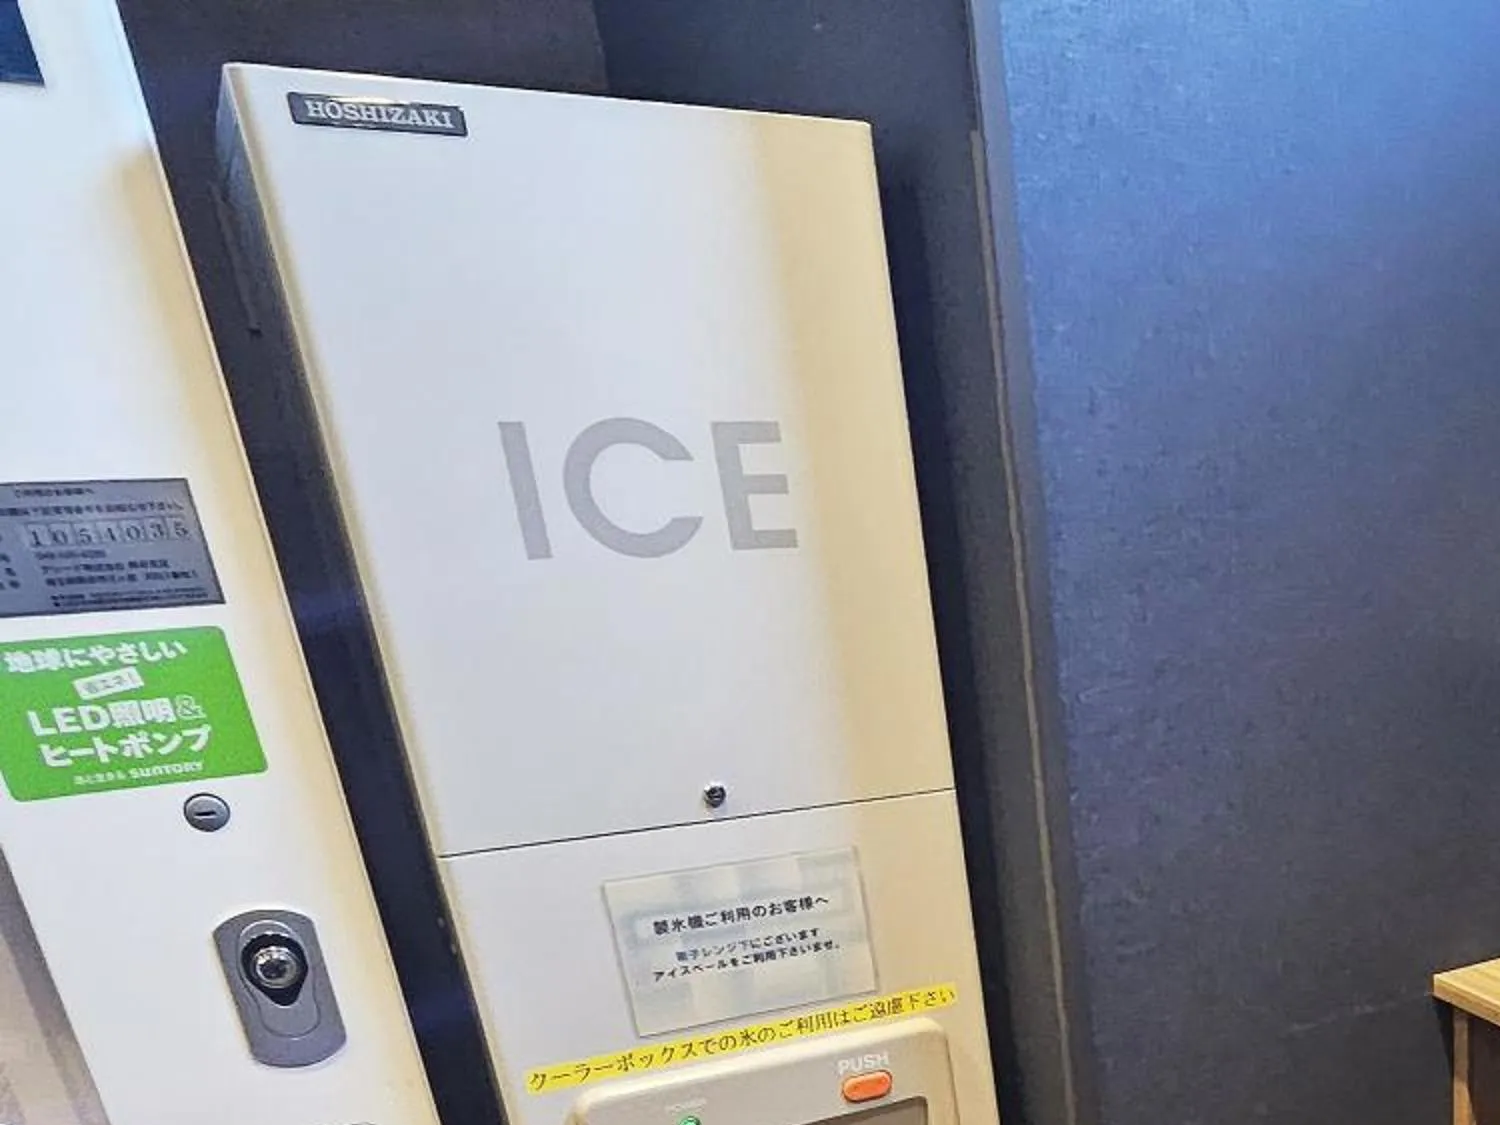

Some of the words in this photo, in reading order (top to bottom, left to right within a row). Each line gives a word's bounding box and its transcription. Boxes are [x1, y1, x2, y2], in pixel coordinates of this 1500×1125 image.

[304, 99, 454, 130] HOSHIZAKI
[496, 416, 799, 561] ICE
[4, 640, 189, 674] 地球にやさしい
[38, 725, 213, 768] ヒートポンプ
[653, 895, 830, 936] 製氷機ご利用のお客様へ
[528, 988, 957, 1091] クーラーボックスでの氷のご利用はご遠慮下さい
[837, 1052, 890, 1076] PUSH
